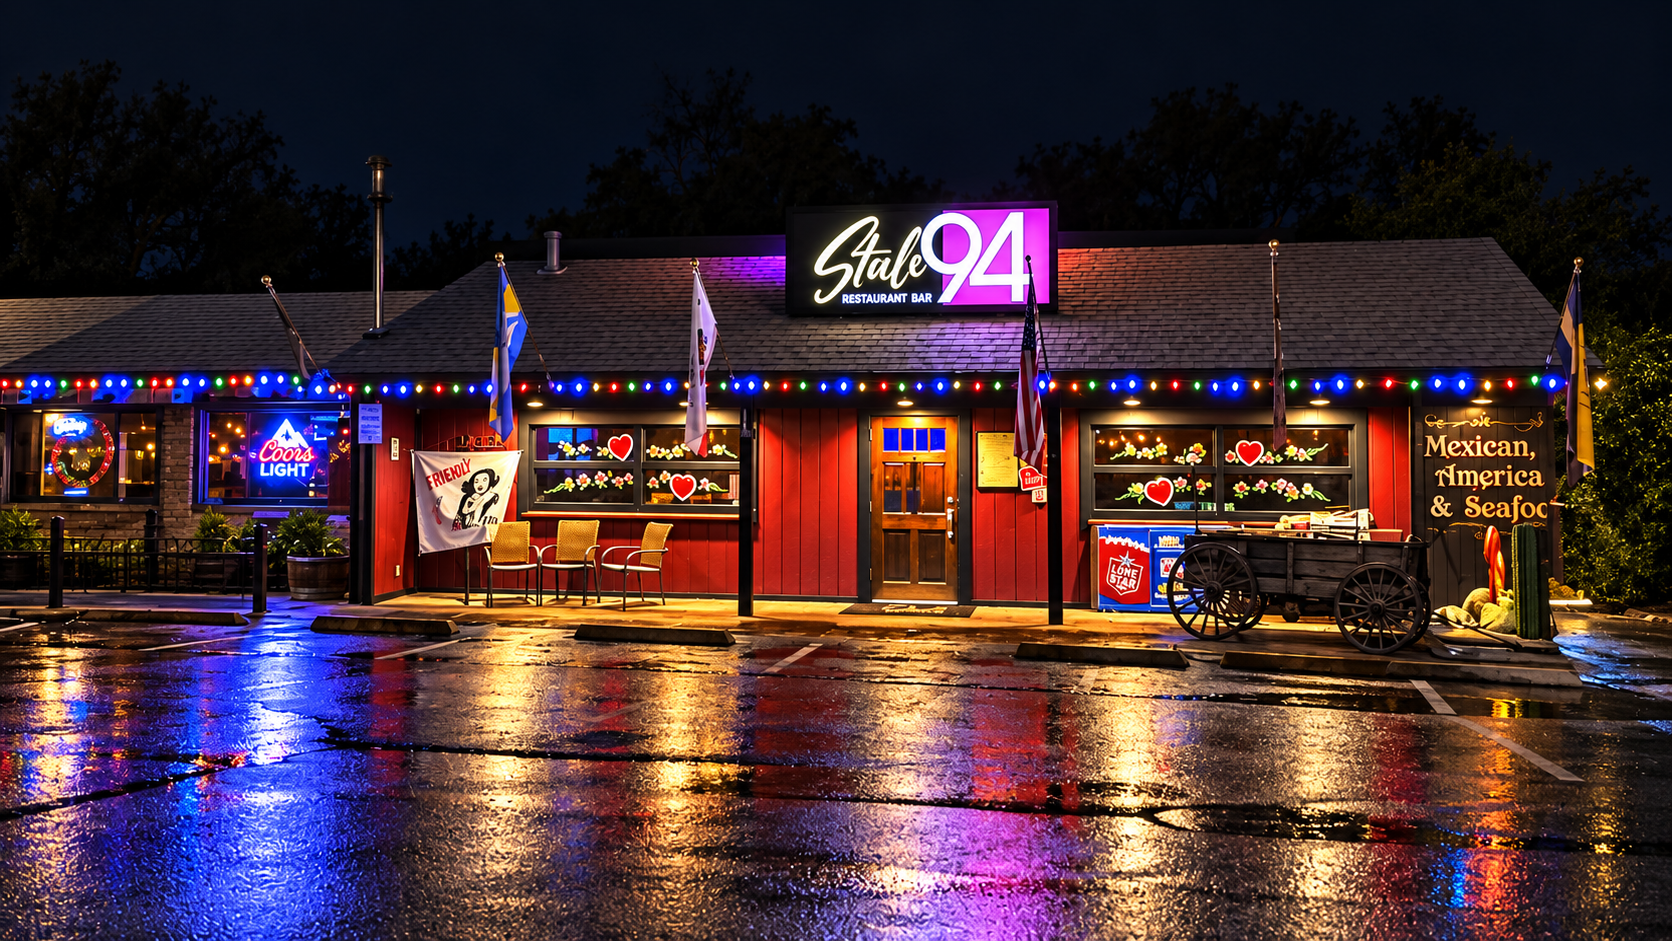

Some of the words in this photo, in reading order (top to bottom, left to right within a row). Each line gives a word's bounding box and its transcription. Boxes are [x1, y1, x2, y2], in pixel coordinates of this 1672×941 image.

[814, 215, 926, 303] Stale
[921, 212, 1030, 303] 94
[842, 293, 908, 304] RESTAURANT
[911, 293, 932, 303] BAR
[260, 439, 314, 462] Coors
[1424, 435, 1535, 460] Mexican,
[260, 463, 309, 477] LIGHT
[426, 458, 471, 490] FRIENDLY
[1435, 463, 1545, 489] America
[1430, 495, 1453, 517] &
[1110, 575, 1136, 589] STAR
[1111, 564, 1138, 578] LONE
